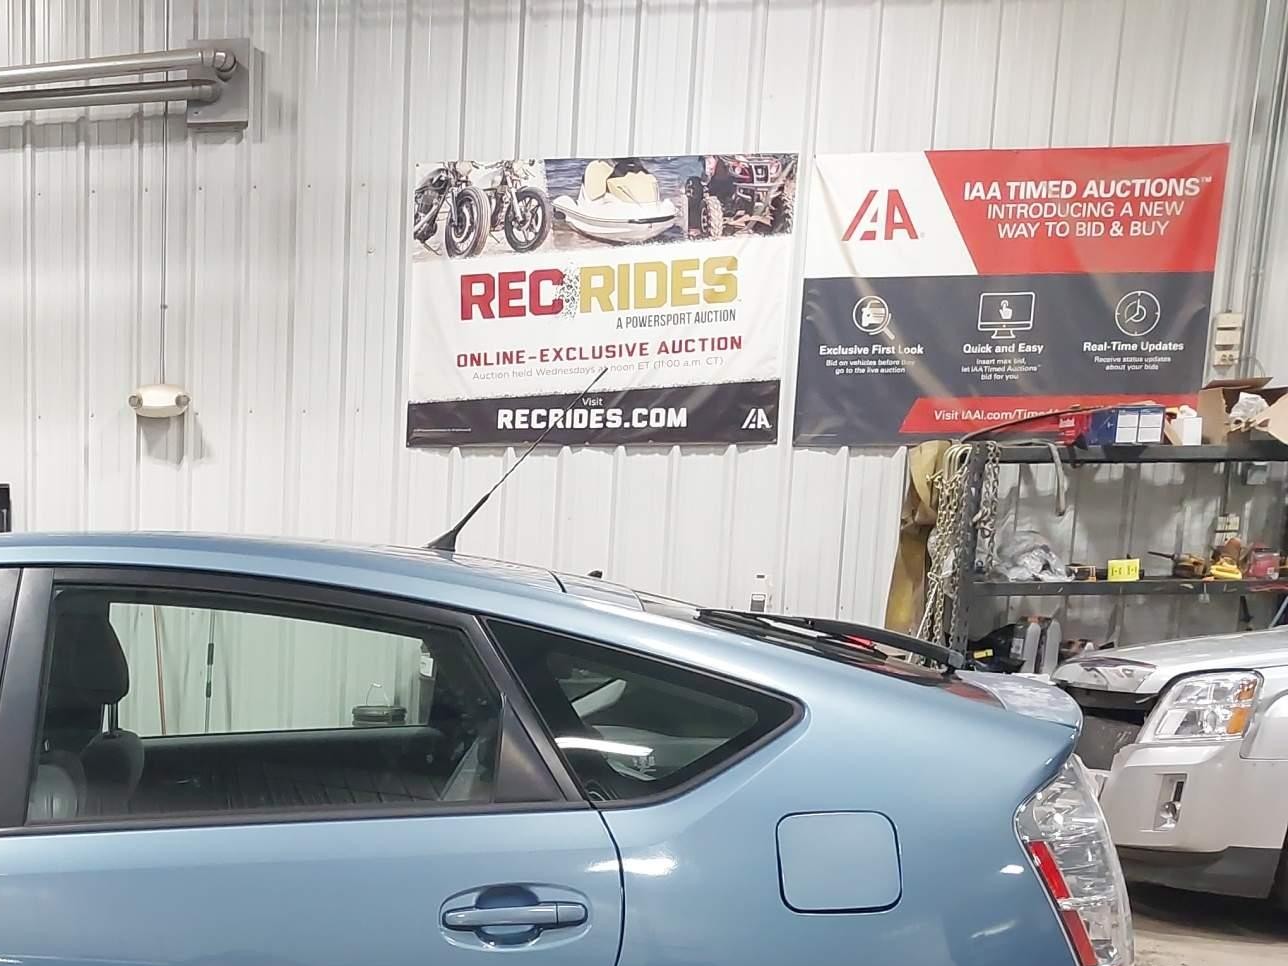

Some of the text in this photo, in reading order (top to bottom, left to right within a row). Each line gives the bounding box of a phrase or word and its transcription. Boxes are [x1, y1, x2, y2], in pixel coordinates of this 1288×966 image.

[964, 181, 1001, 201] IAA
[1006, 180, 1077, 200] TIMED
[987, 200, 1185, 220] INTRODUCING A NEW
[997, 220, 1170, 239] WAY TO BID & BUY
[460, 256, 738, 321] REC RIDES
[616, 309, 736, 330] A POWERSPORT AUCTION
[456, 335, 742, 368] ONLINE-EXCLUSIVE AUCTION
[819, 344, 924, 355] Exclusive First Look
[963, 342, 1044, 354] Quick and Easy
[1082, 340, 1185, 352] Real-Time Updates
[472, 371, 510, 381] Auction
[512, 368, 533, 378] held
[535, 363, 596, 377] Wednesdays
[610, 363, 635, 372] noon
[638, 361, 650, 370] ET
[705, 356, 724, 366] CT)
[582, 397, 603, 406] Visit
[497, 407, 688, 430] RECRIDES.COM
[934, 409, 959, 421] Visit
